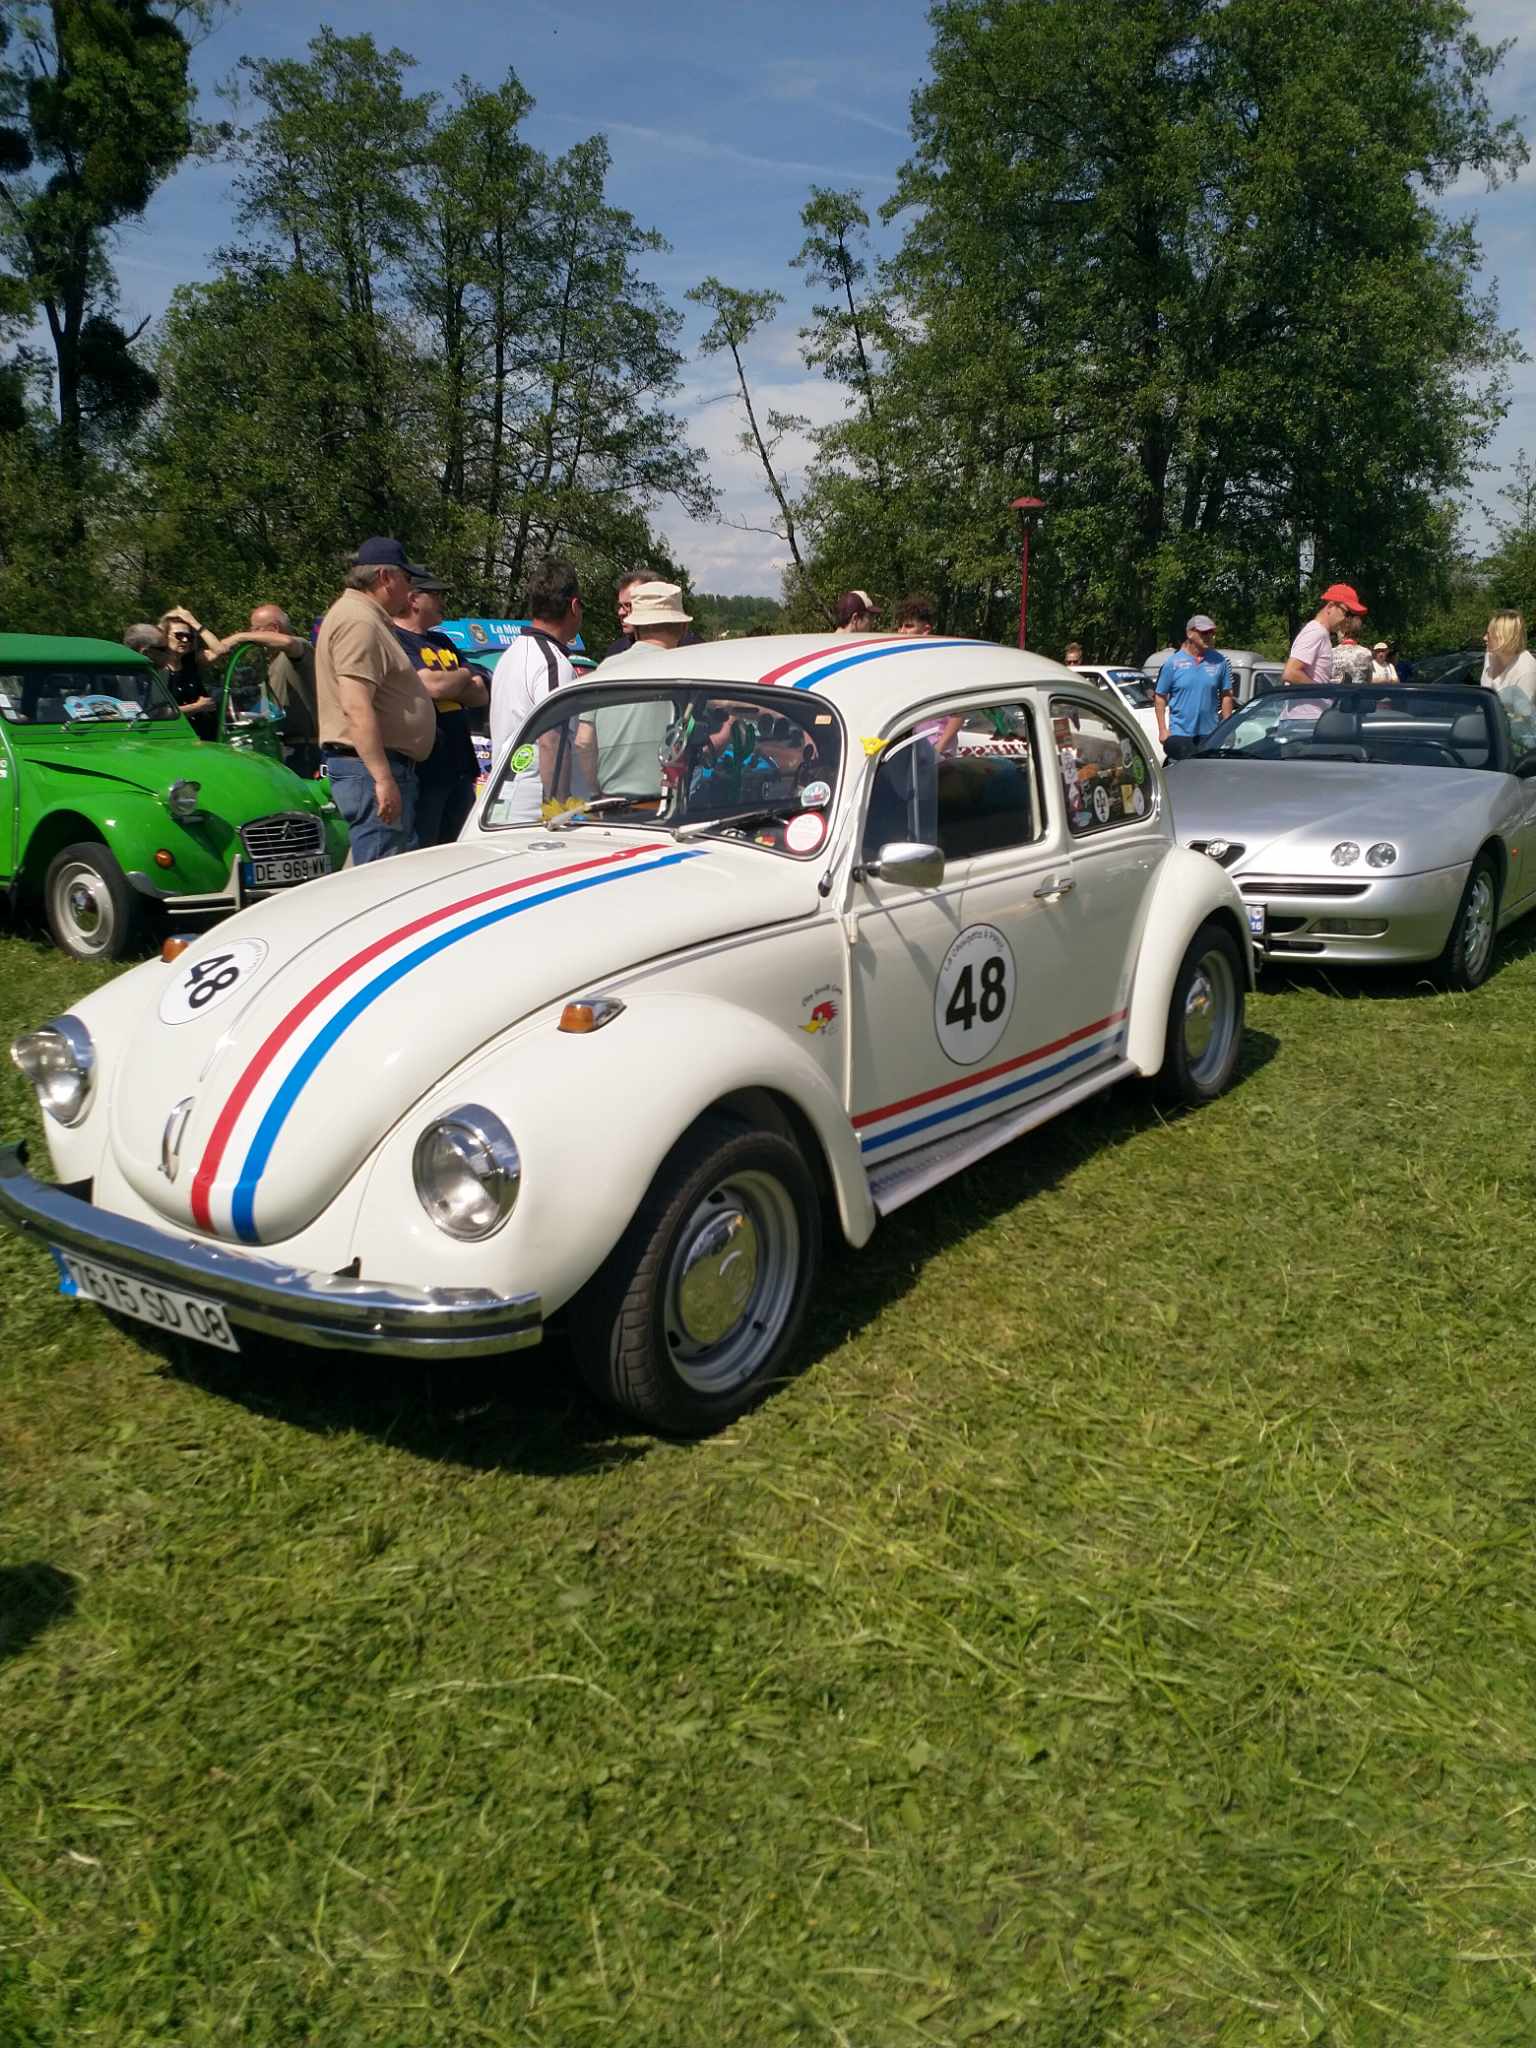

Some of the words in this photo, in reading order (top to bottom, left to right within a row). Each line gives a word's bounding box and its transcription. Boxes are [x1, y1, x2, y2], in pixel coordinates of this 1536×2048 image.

[489, 623, 503, 634] La
[184, 953, 239, 1009] 48
[945, 955, 1006, 1031] 48
[68, 1259, 140, 1313] 7615
[140, 1287, 181, 1328] SD
[185, 1301, 230, 1345] 08
